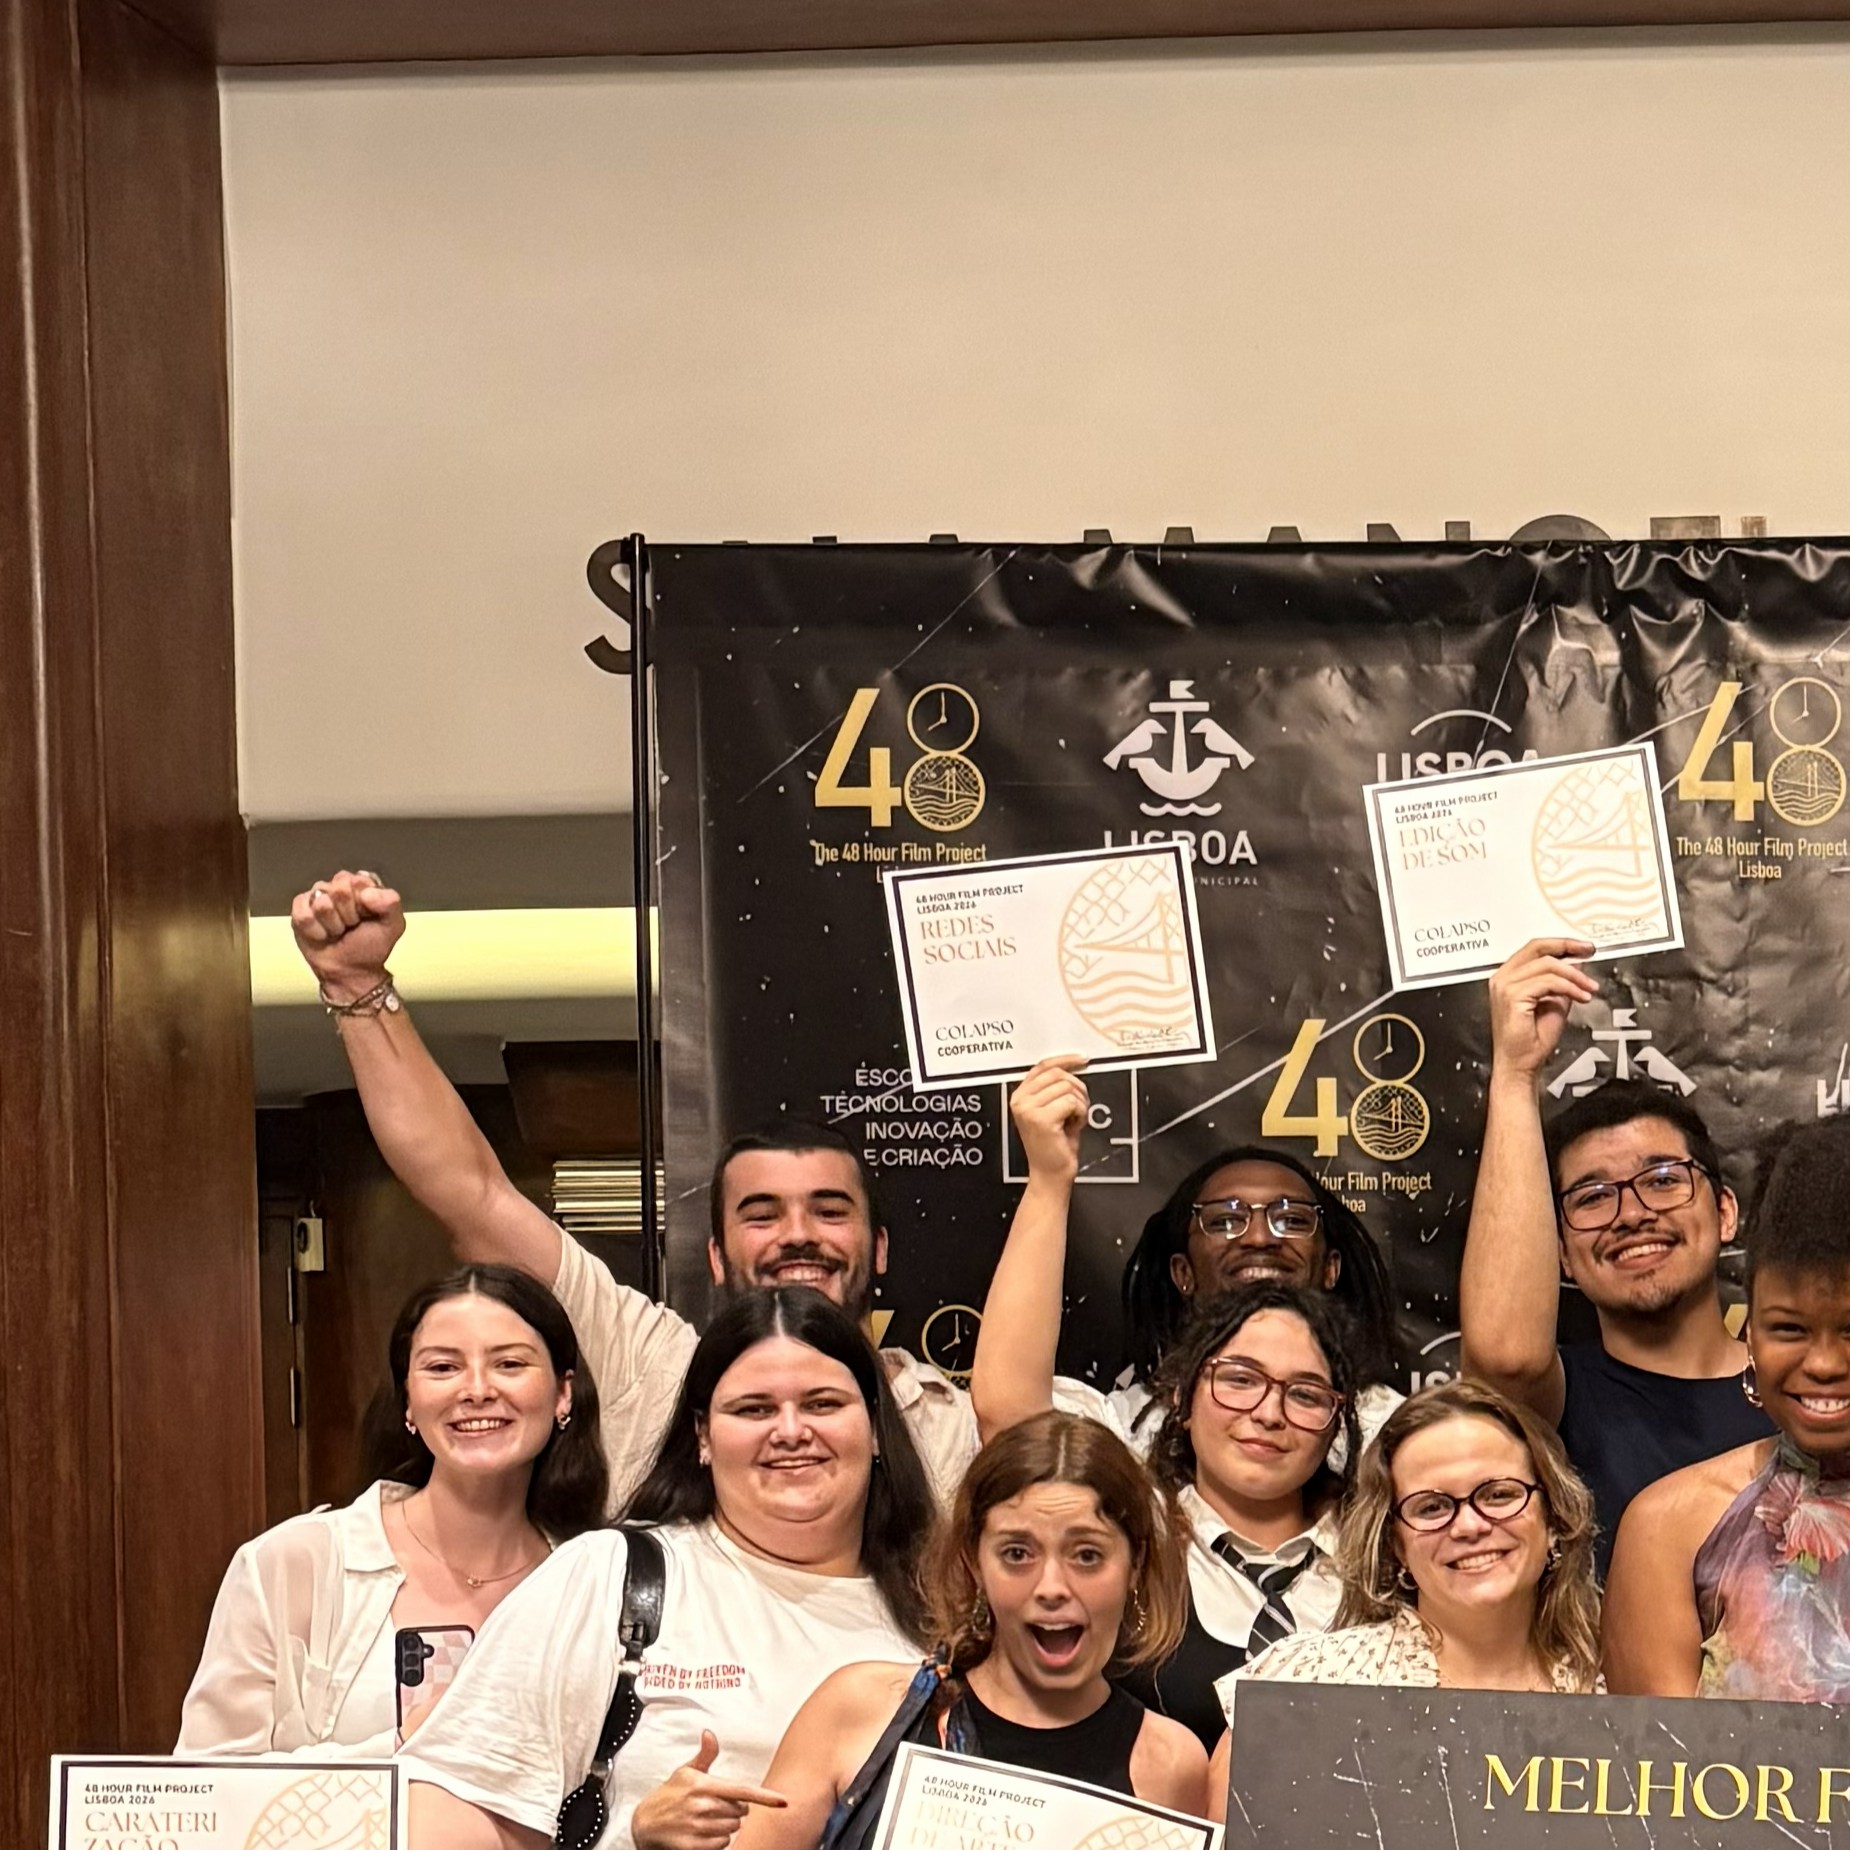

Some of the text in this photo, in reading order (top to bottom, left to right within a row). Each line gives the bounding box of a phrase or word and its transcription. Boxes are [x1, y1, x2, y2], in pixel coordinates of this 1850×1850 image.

[1400, 818, 1485, 849] EDIÇÃO
[814, 841, 986, 863] The 48 Hour Film Project
[1404, 841, 1486, 870] DE SOM
[1676, 837, 1848, 859] The 48 Hour Film Project
[1739, 860, 1782, 879] Lisboa
[983, 884, 1023, 897] PROJECT
[1195, 876, 1258, 886] NICIPAL
[921, 914, 994, 940] REDES
[1414, 919, 1490, 943] COLAPSO
[924, 937, 1017, 965] SOCIAIS
[1417, 938, 1489, 957] COOPERATIVA
[935, 1019, 1014, 1044] COLAPSO
[938, 1040, 1013, 1057] COOPERATIVA
[855, 1068, 912, 1087] ESCO
[820, 1094, 982, 1113] TECNOLOGIAS
[866, 1117, 983, 1143] INOVAÇÃO
[864, 1143, 983, 1169] E CRIAÇÃO
[1348, 1171, 1378, 1191] Film
[1382, 1171, 1431, 1193] Project
[85, 1795, 125, 1804] LISBOA
[102, 1784, 132, 1793] HOUR
[136, 1784, 161, 1793] FILM
[165, 1784, 214, 1794] PROJECT
[940, 1778, 969, 1791] HOUR
[999, 1790, 1046, 1809] PROJECT
[1483, 1754, 1804, 1823] MELHOR
[85, 1811, 216, 1833] CARATERI
